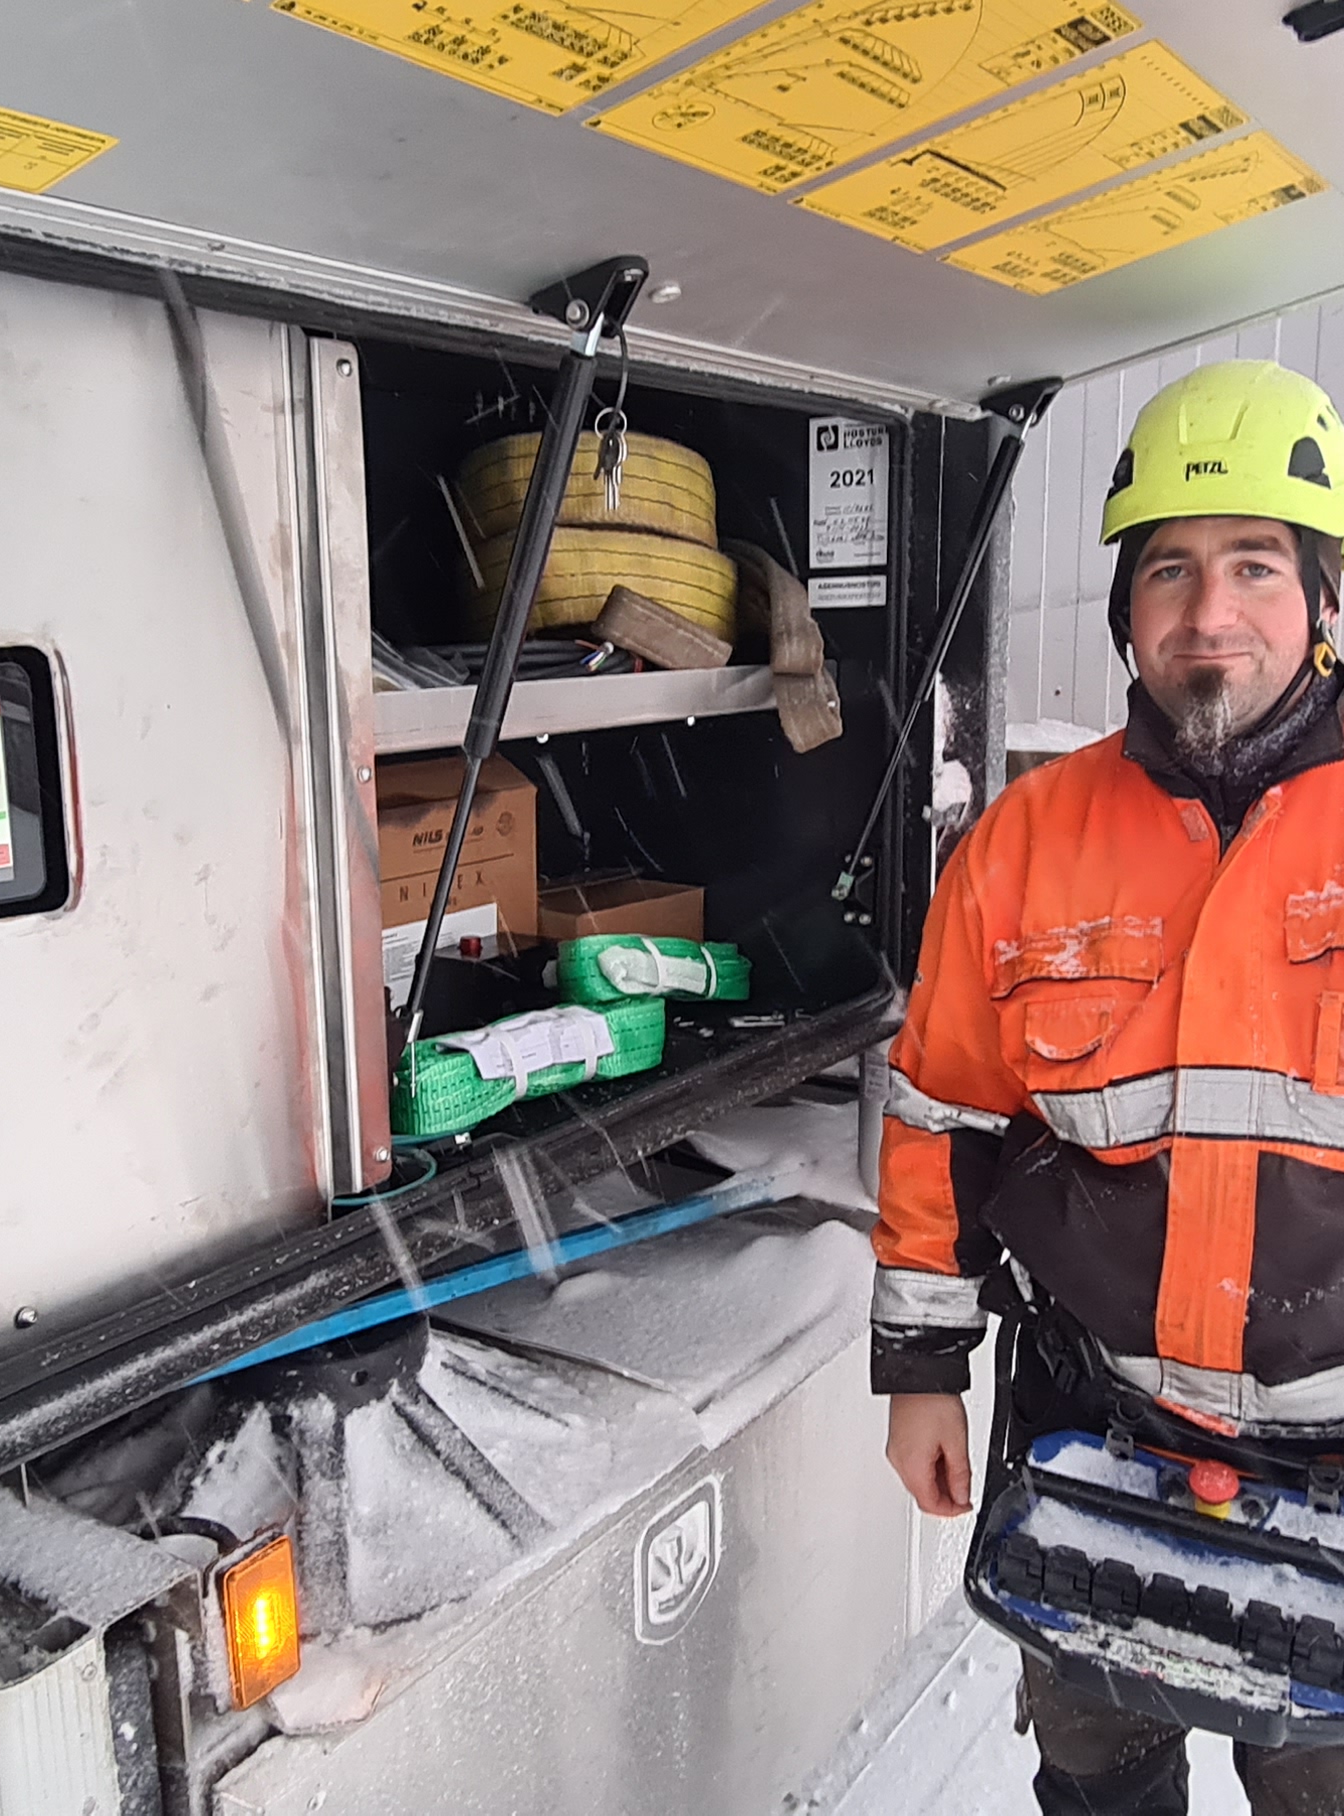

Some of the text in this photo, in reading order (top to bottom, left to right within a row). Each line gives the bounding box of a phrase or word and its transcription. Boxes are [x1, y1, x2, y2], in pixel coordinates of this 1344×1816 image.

[830, 468, 874, 489] 2021
[1185, 459, 1229, 482] PETZL
[412, 829, 443, 847] NILS
[399, 870, 485, 902] NIEX
